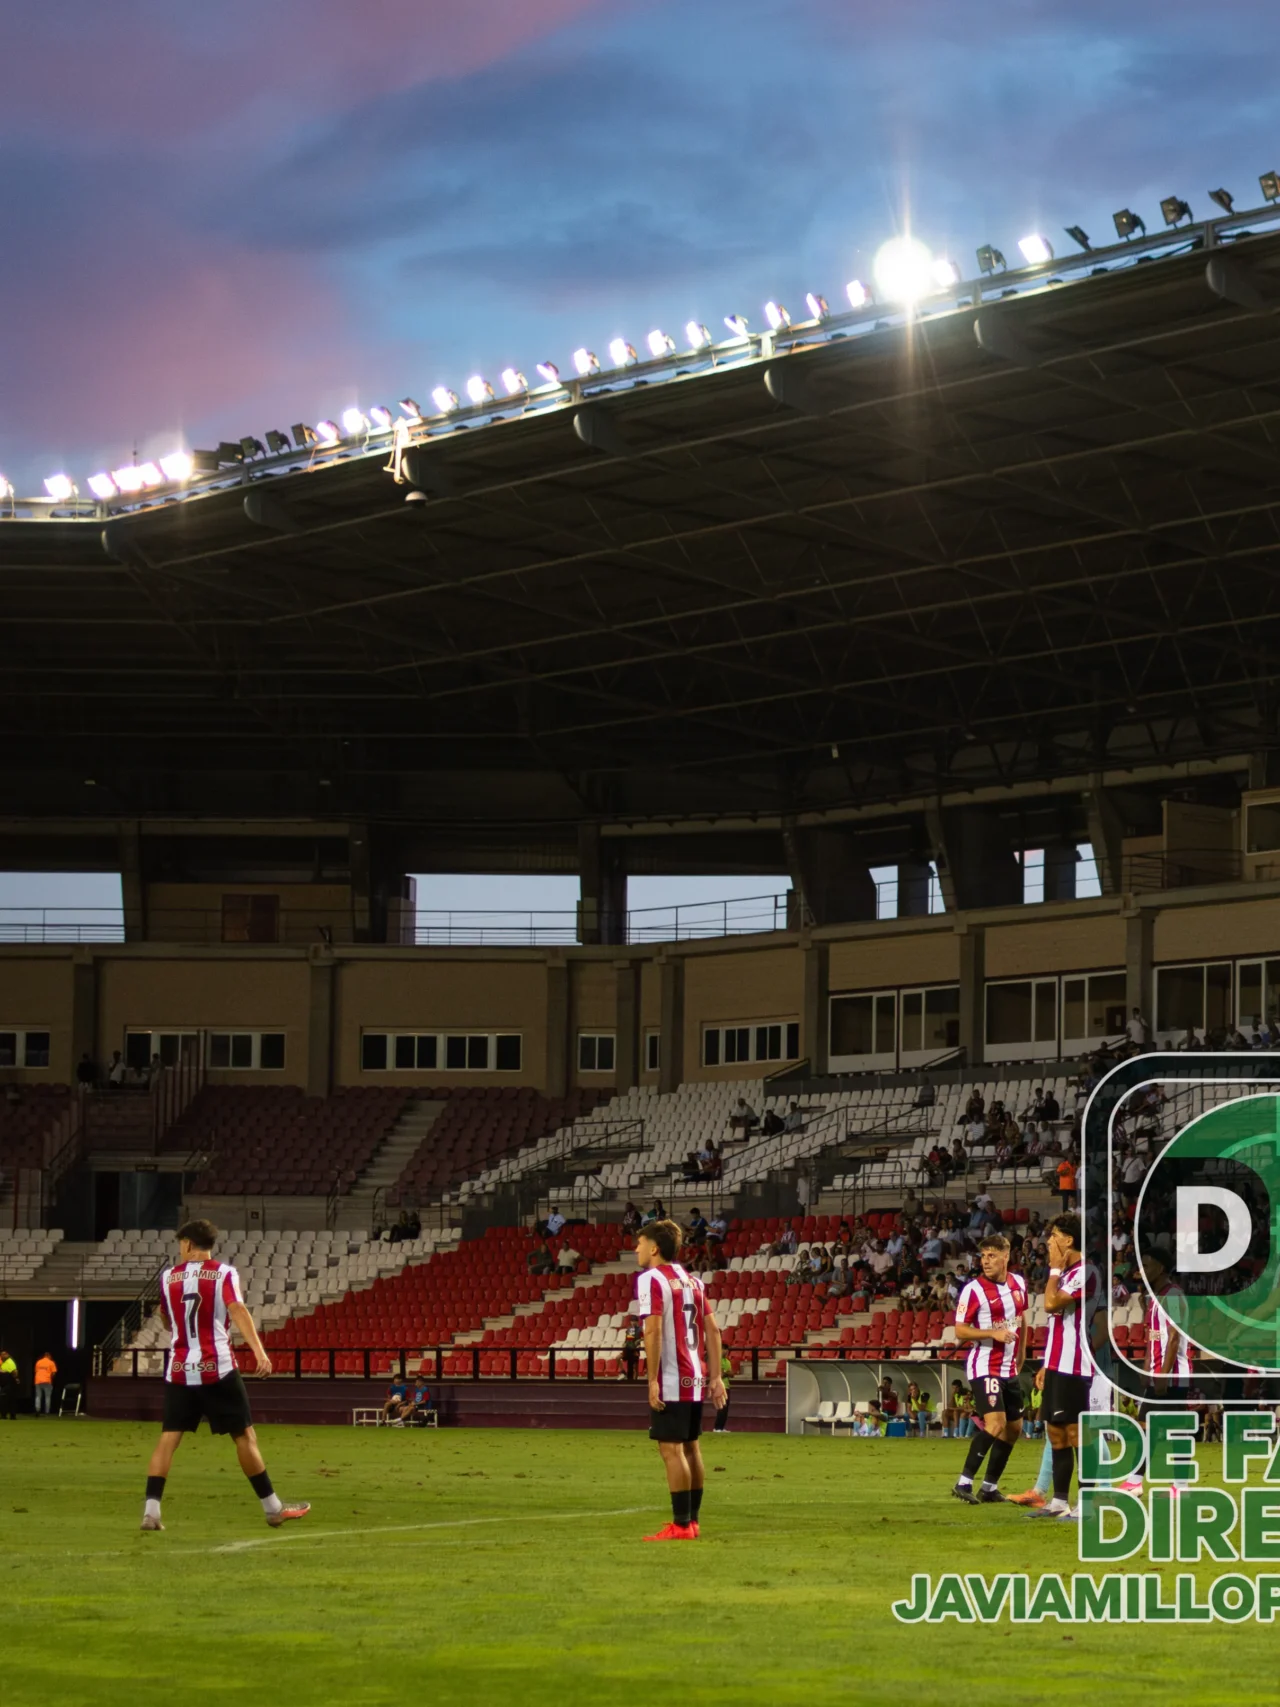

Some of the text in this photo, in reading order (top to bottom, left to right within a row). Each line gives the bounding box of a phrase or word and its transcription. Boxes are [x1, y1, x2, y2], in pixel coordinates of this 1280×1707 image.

[166, 1269, 222, 1284] DAVID AMIGO
[181, 1292, 203, 1338] 7
[682, 1303, 699, 1350] 3
[984, 1378, 999, 1394] 16
